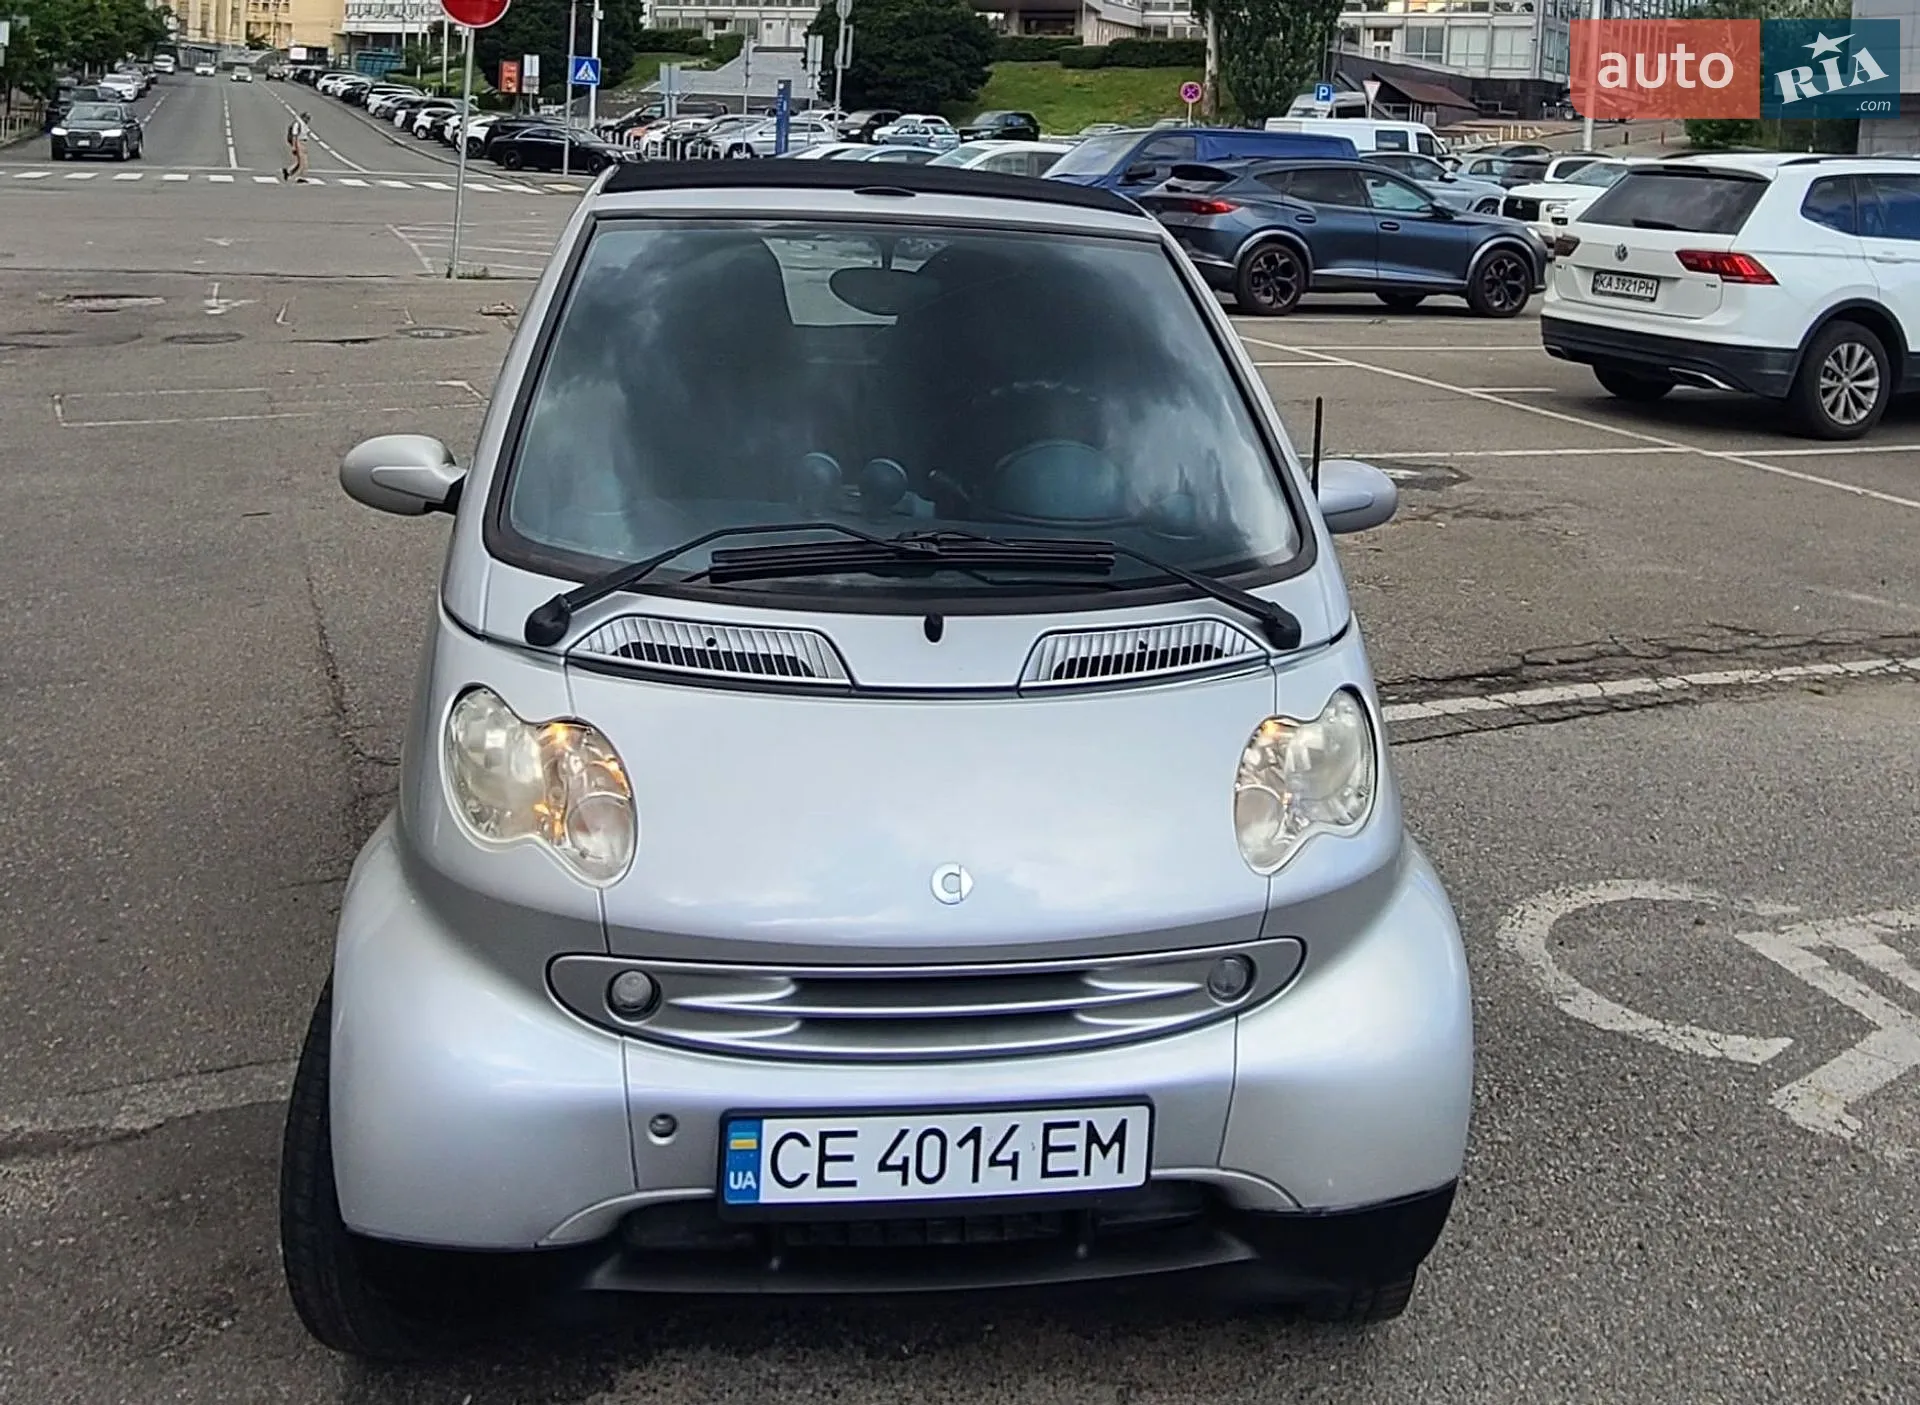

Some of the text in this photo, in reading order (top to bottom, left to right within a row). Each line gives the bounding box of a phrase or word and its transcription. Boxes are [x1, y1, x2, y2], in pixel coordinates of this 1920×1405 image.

[1319, 86, 1328, 100] P
[1598, 276, 1613, 289] KA
[1638, 280, 1654, 294] PH
[770, 1118, 1128, 1189] CE 4014 EM
[729, 1171, 756, 1190] UA
